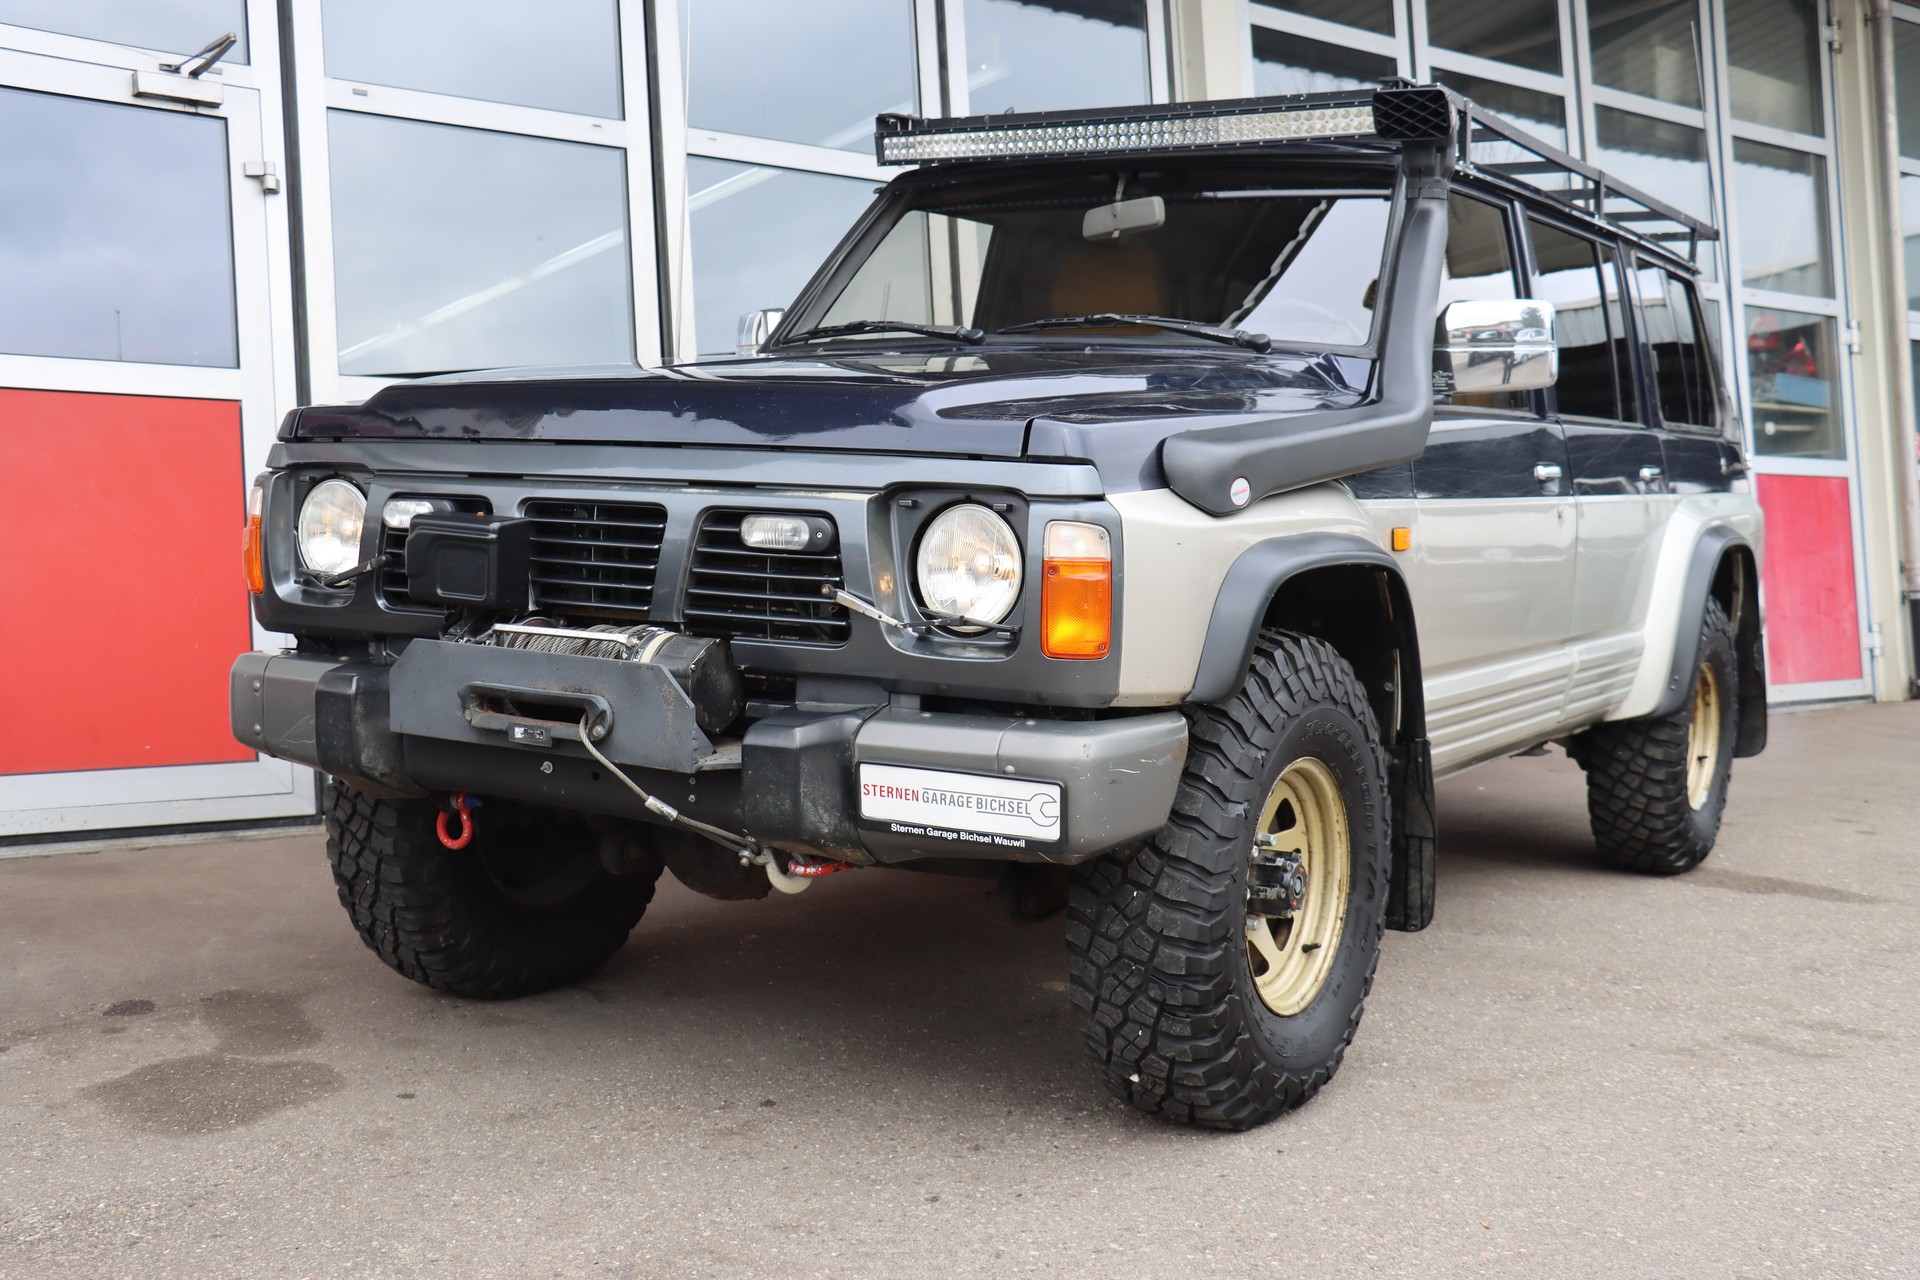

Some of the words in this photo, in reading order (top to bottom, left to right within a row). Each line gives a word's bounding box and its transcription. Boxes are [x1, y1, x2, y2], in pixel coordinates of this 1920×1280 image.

[863, 783, 919, 802] STERNEN
[922, 791, 972, 808] GARAGE
[976, 799, 1031, 815] BICHSEL
[891, 823, 925, 835] Sternen
[926, 827, 958, 840] Garage
[960, 831, 992, 844] Bichsel
[994, 836, 1025, 848] Wauwil
